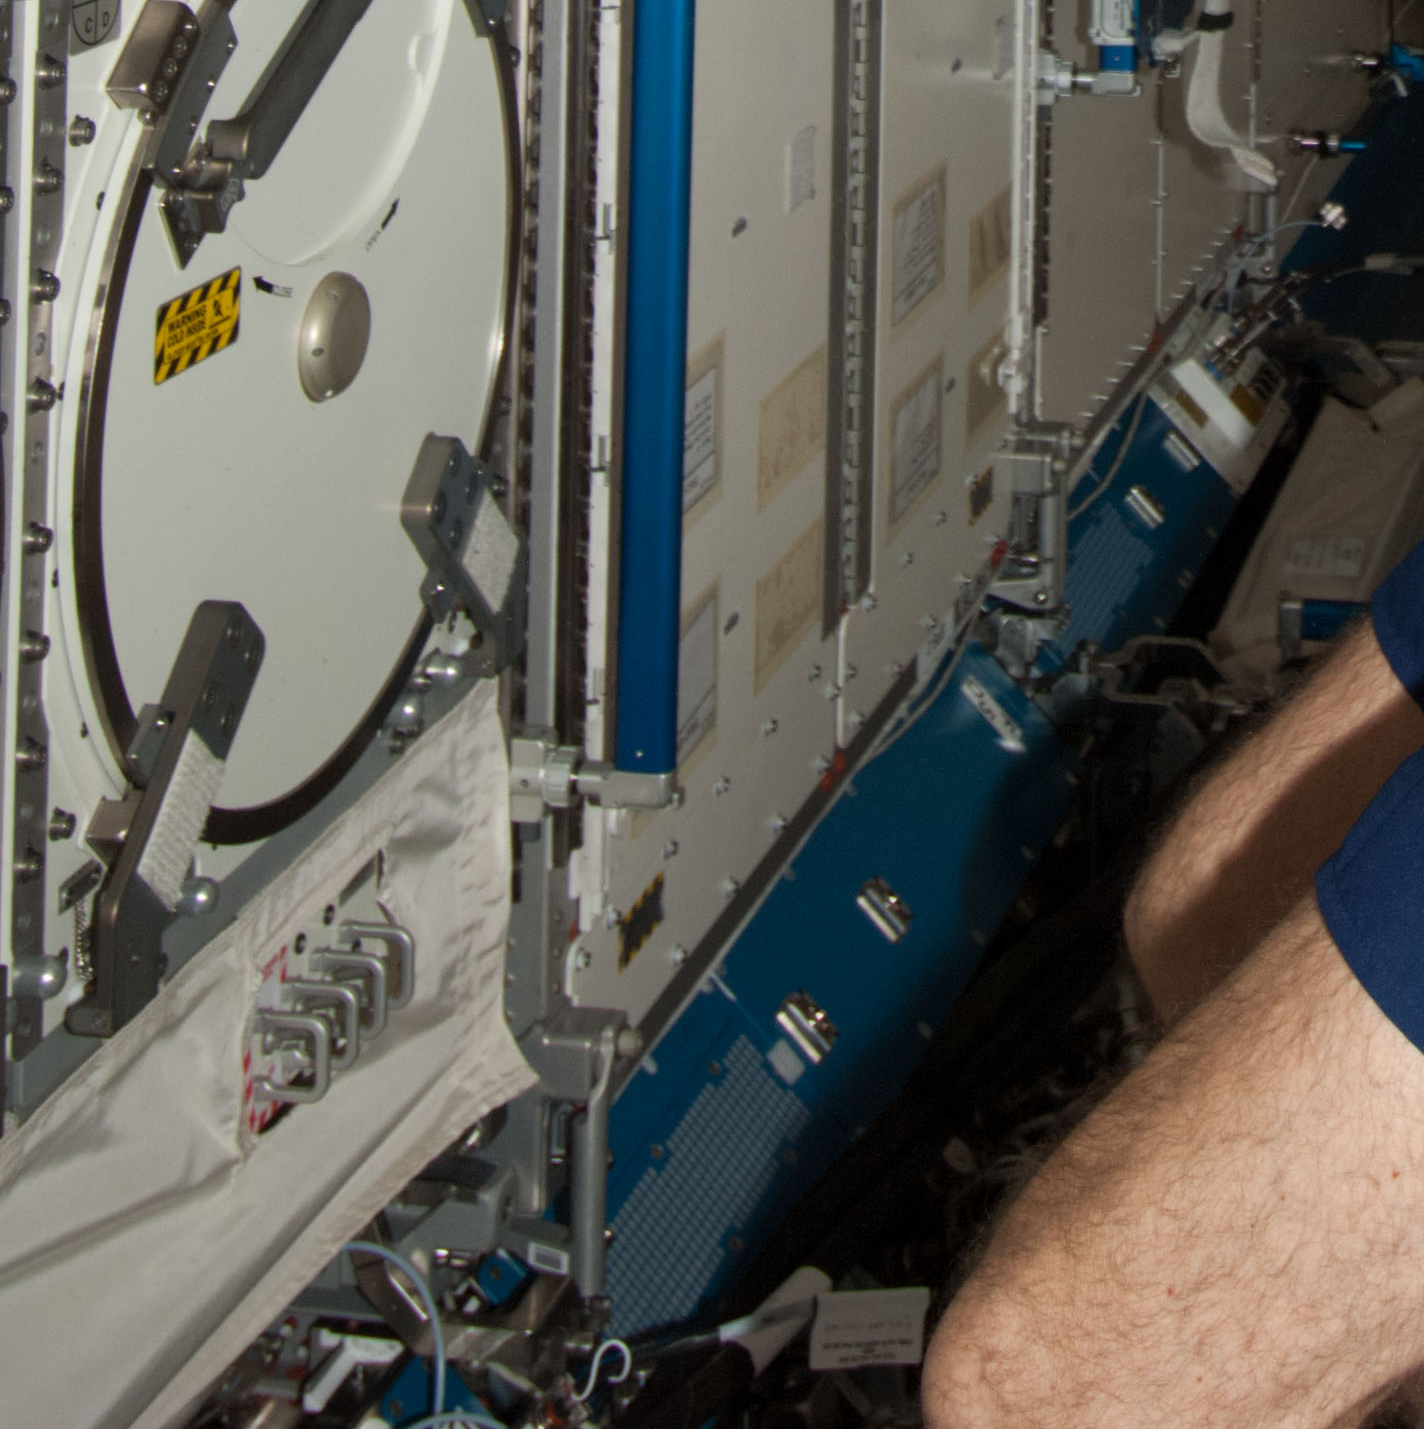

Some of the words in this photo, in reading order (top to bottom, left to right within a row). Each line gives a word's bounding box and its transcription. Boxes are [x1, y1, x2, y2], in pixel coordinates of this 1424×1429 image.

[84, 16, 94, 35] C
[101, 10, 111, 29] D
[167, 303, 207, 333] WARNING
[167, 330, 185, 348] COLD
